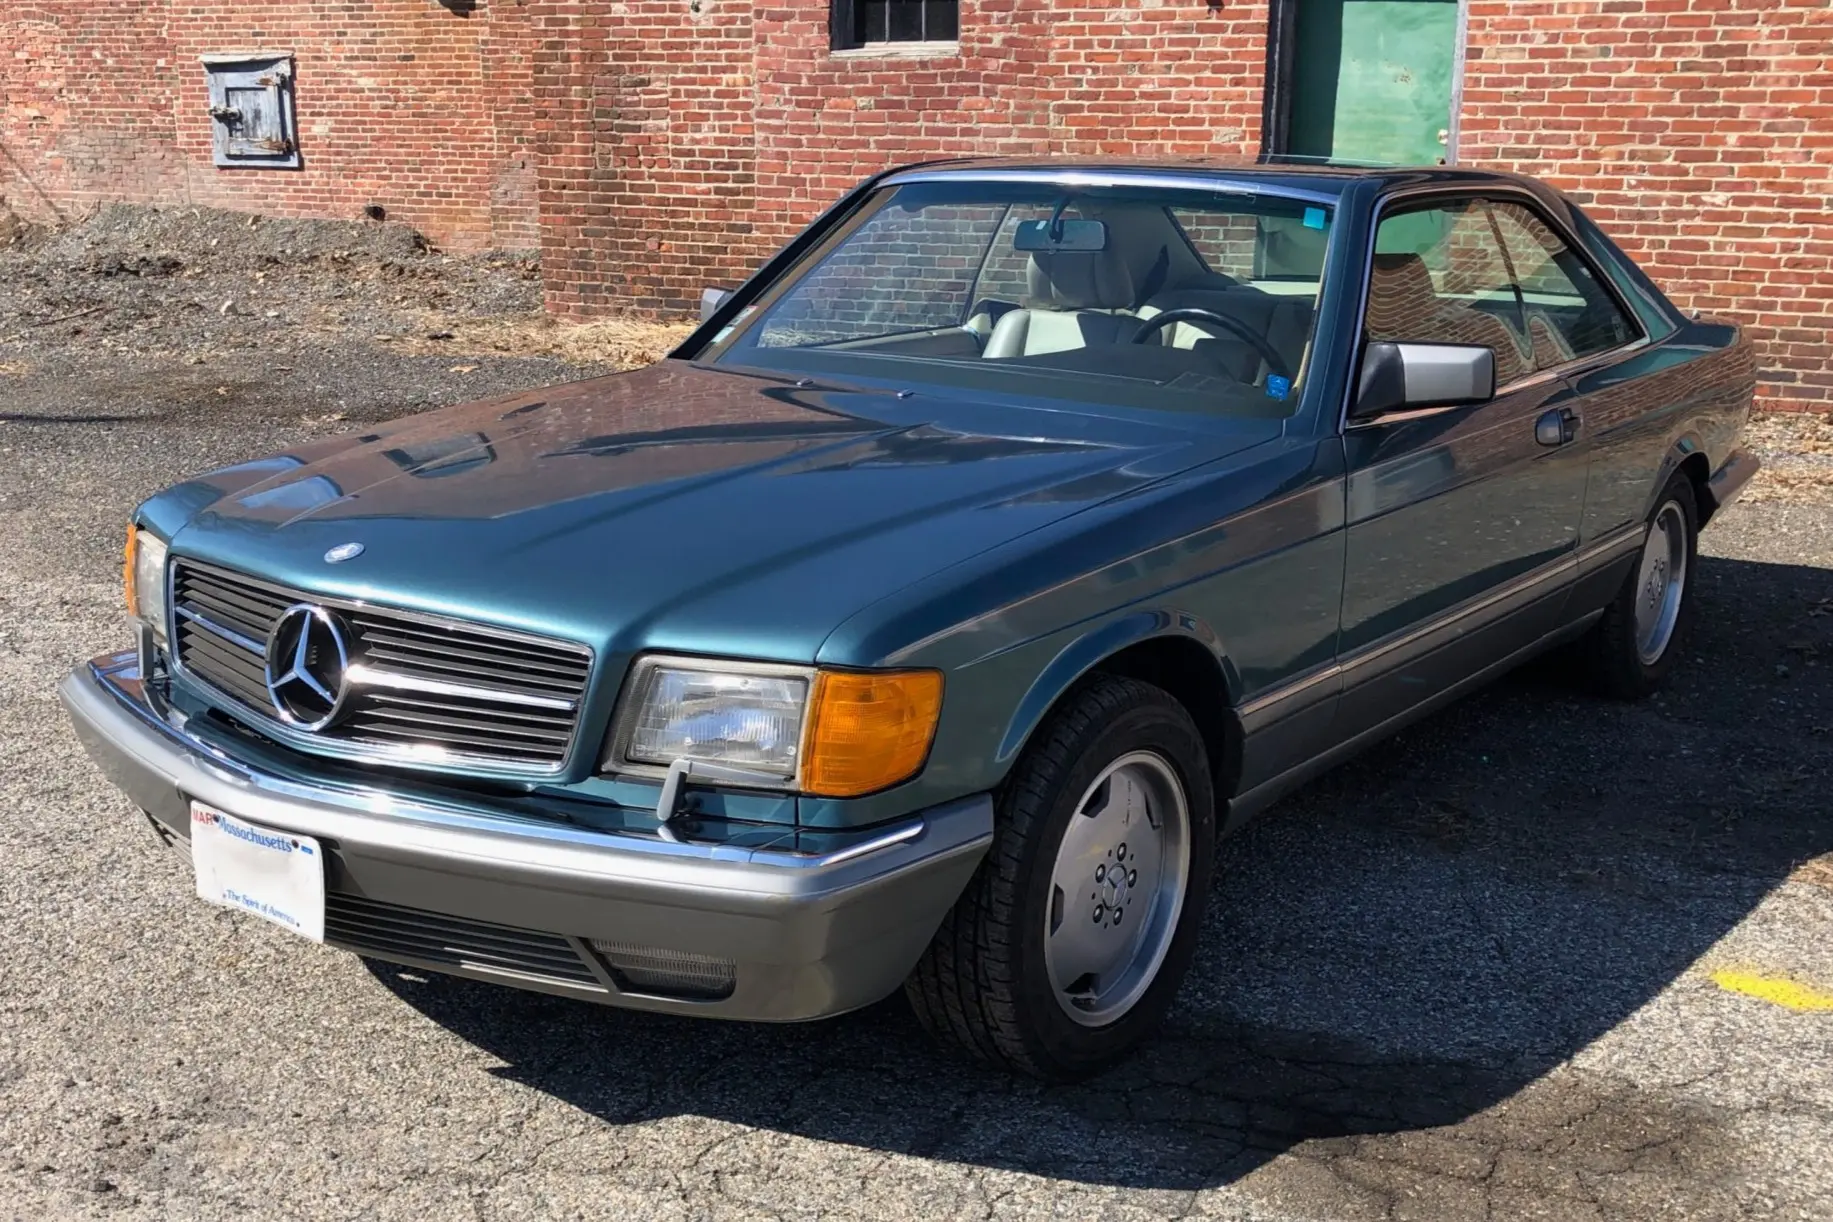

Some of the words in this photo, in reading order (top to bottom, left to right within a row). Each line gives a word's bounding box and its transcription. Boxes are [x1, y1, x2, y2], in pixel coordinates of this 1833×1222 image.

[218, 815, 292, 852] Massachusetts
[227, 889, 240, 901] The
[242, 895, 259, 909] Spirit
